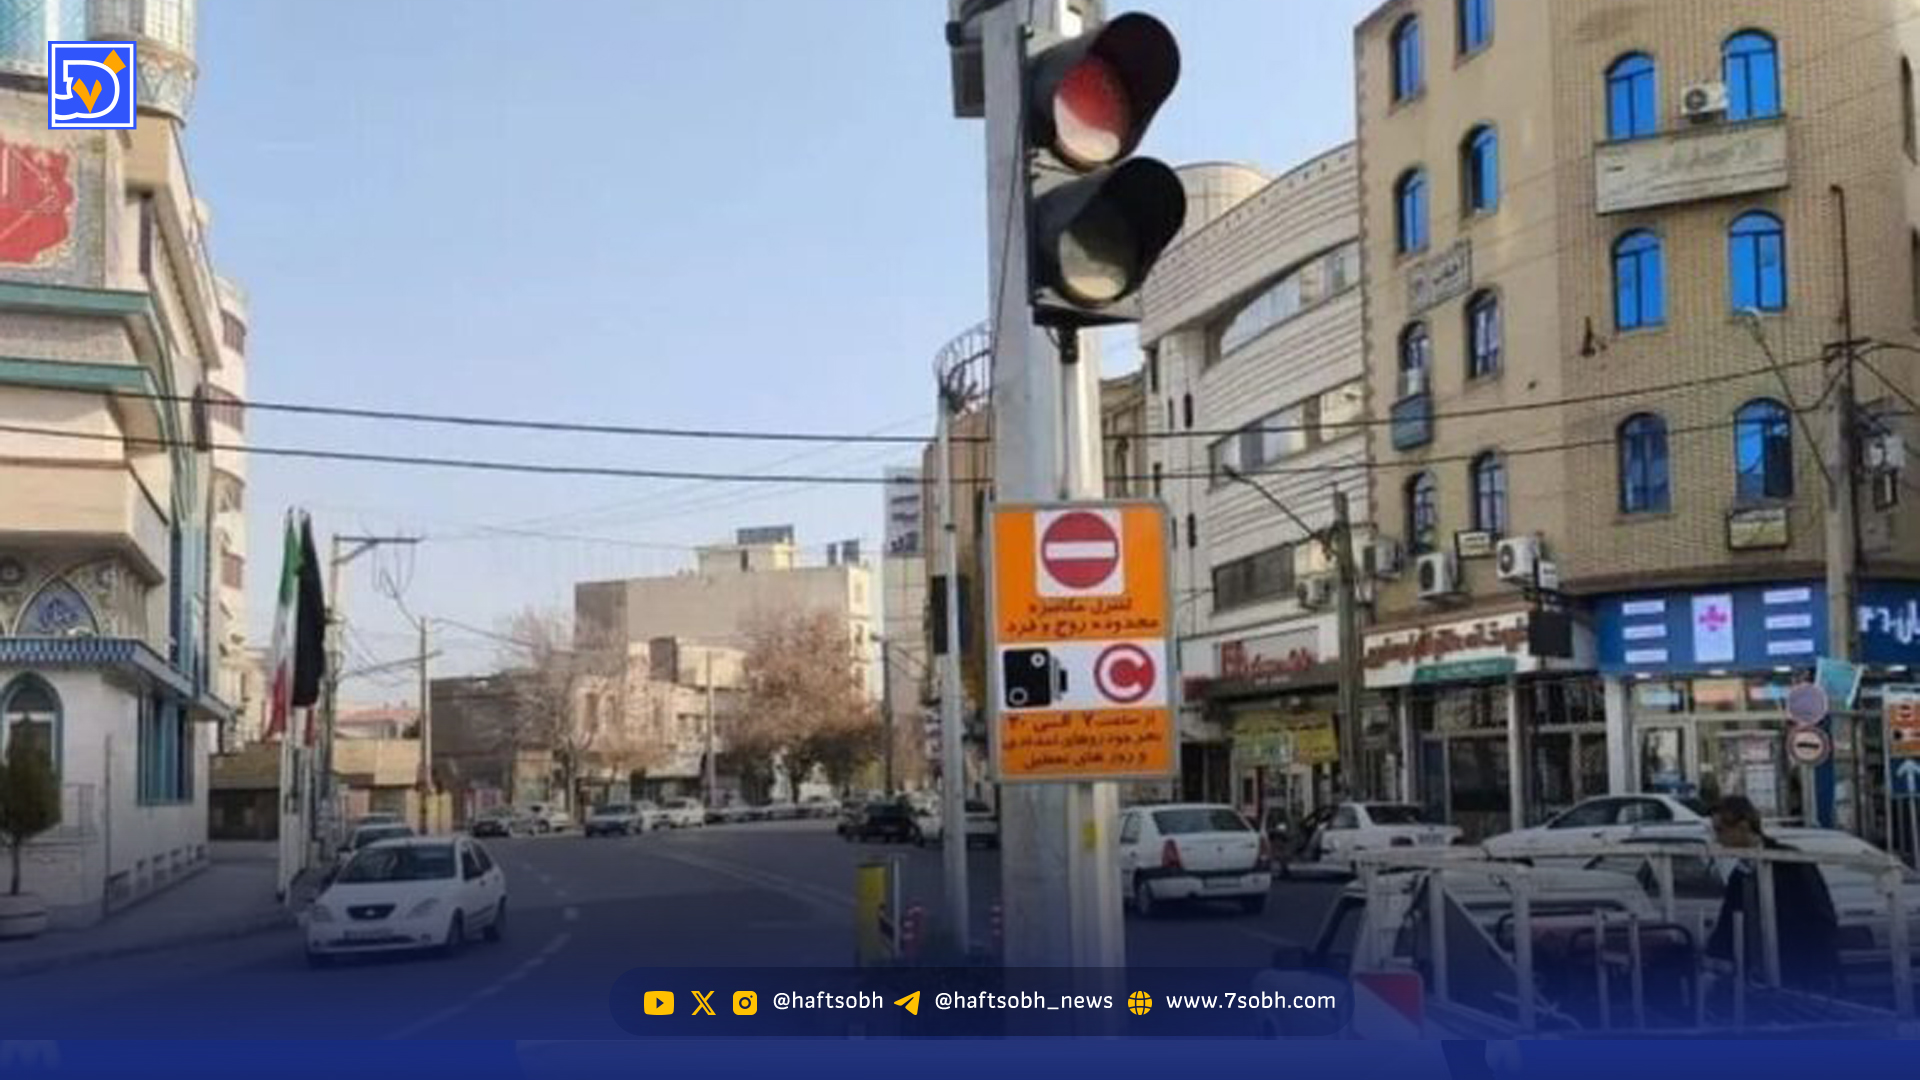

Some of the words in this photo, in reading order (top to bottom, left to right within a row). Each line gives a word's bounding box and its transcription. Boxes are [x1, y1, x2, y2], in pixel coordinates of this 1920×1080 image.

[1005, 619, 1037, 636] فرد
[1055, 620, 1086, 637] زوج
[1092, 619, 1159, 634] محدوده
